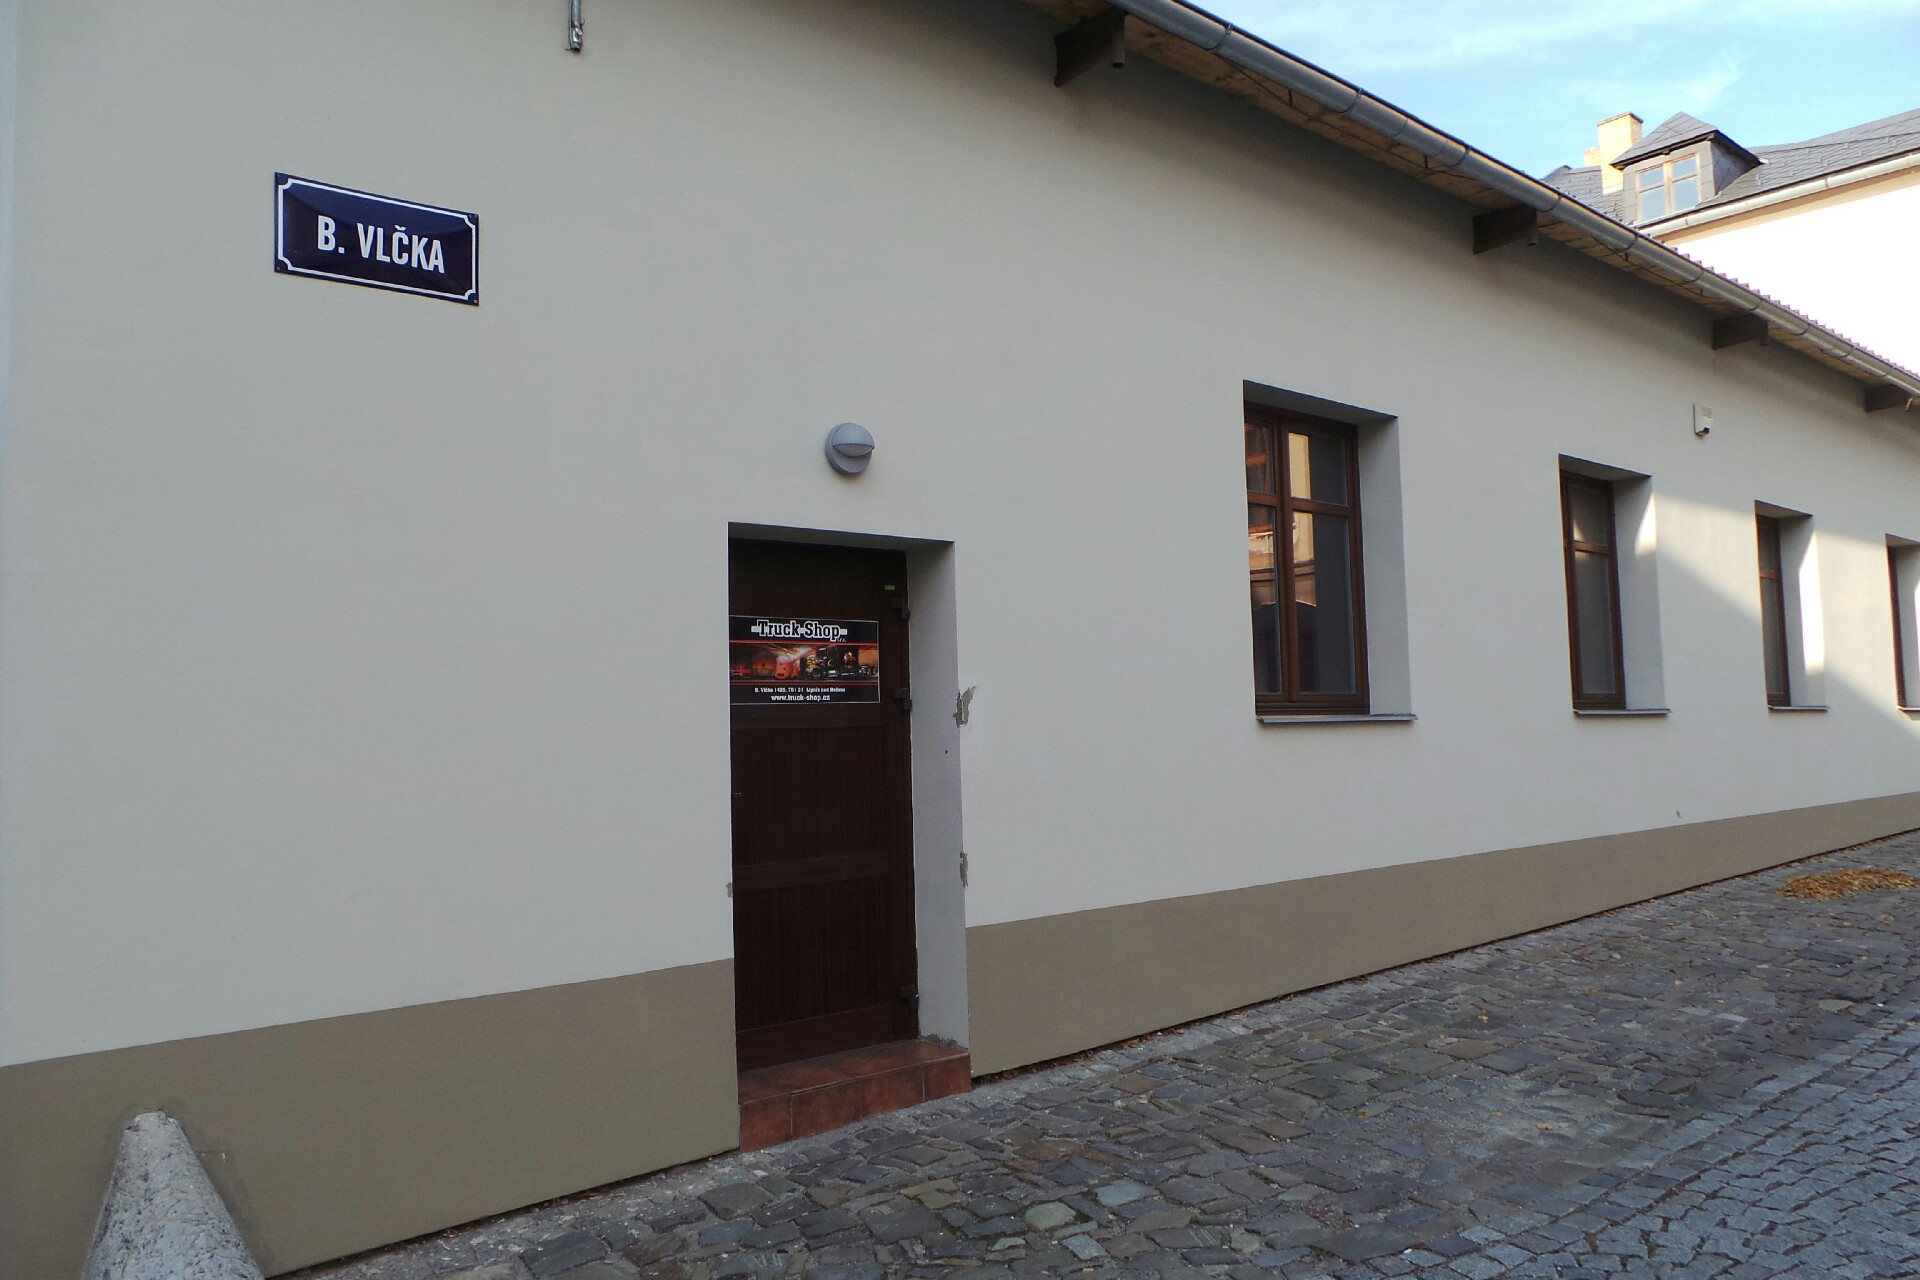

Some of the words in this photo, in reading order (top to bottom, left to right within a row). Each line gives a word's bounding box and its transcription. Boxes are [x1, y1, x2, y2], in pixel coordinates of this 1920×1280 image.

[317, 215, 345, 254] B.
[356, 222, 445, 274] VLČKA
[757, 619, 800, 637] Truck
[804, 621, 841, 642] Shop
[770, 694, 831, 703] www.truck-shop.cz
